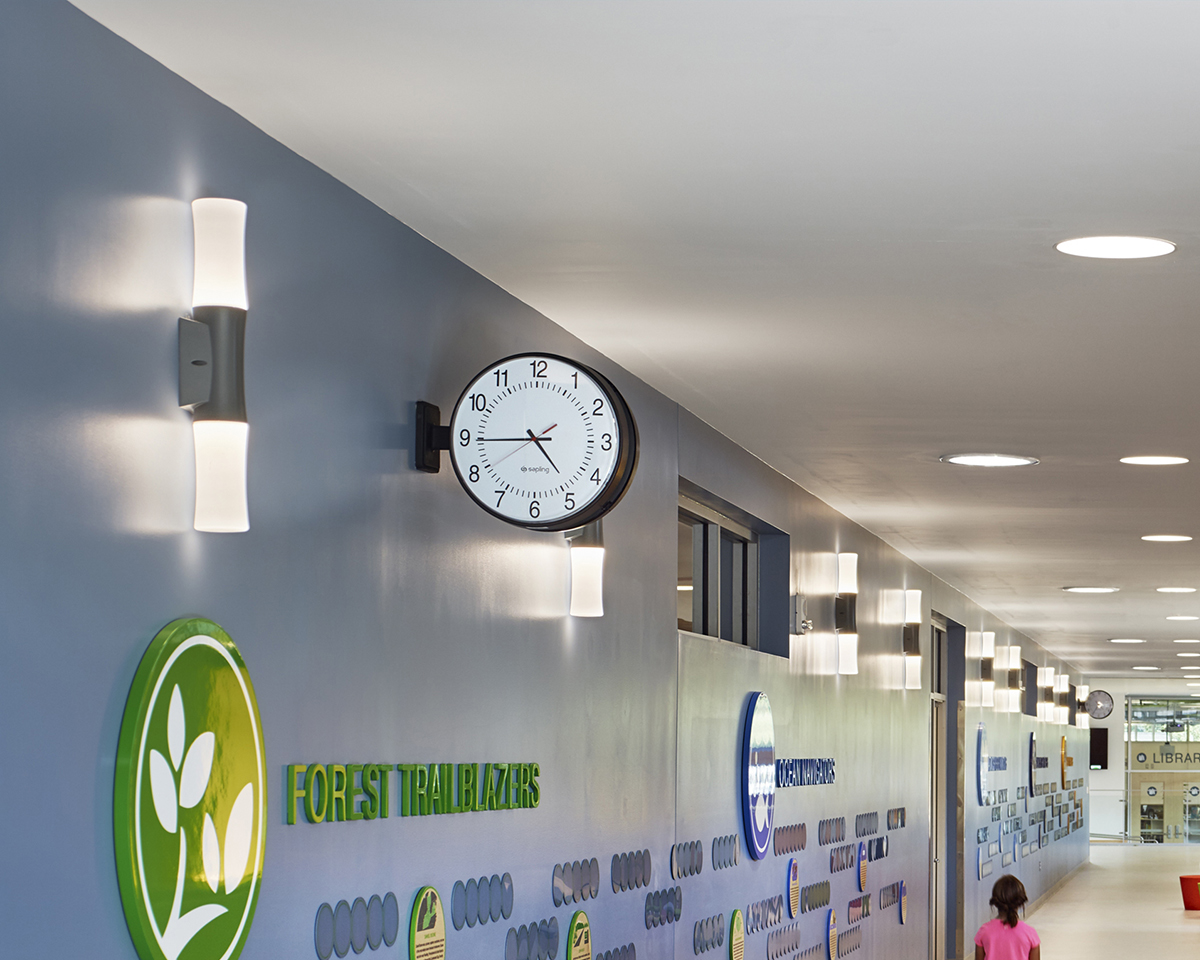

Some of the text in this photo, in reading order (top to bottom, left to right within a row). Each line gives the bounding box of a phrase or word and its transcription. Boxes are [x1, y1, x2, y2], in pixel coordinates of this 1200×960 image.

[493, 369, 509, 387] 11
[530, 360, 548, 378] 12
[571, 372, 578, 389] 1
[469, 393, 486, 411] 10
[592, 398, 604, 416] 2
[459, 429, 471, 447] 9
[601, 433, 612, 451] 3
[469, 465, 480, 482] 8
[590, 468, 601, 485] 4
[494, 490, 506, 508] 7
[564, 493, 575, 510] 5
[529, 501, 540, 518] 6
[776, 758, 800, 788] OCEAN
[287, 762, 541, 825] FOREST TRAILBLAZERS
